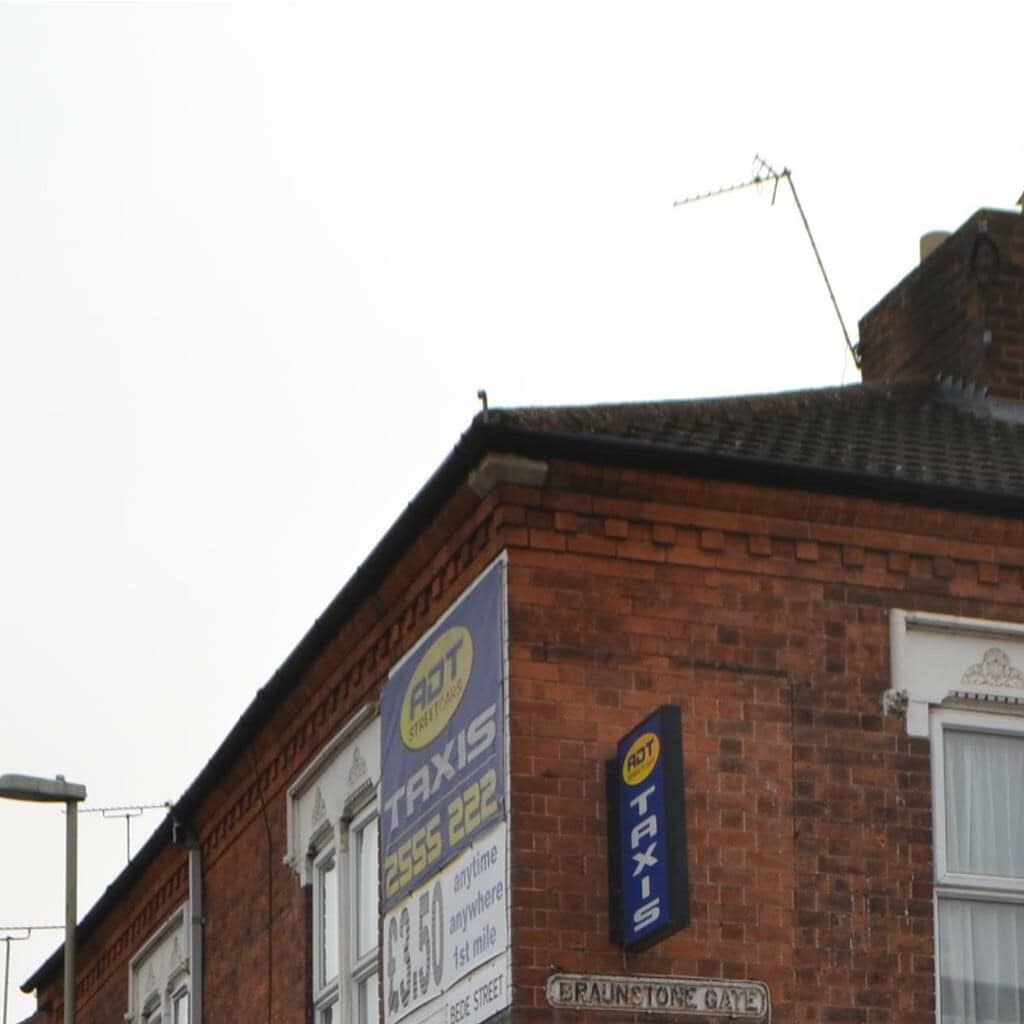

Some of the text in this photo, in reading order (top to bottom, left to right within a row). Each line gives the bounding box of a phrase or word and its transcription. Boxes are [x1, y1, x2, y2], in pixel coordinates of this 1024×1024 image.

[410, 637, 464, 721] ADT
[384, 703, 497, 829] TAXIS
[627, 737, 654, 772] ADT
[384, 768, 499, 898] 2555 222
[629, 784, 661, 932] TAXIS
[453, 845, 498, 893] anytime
[449, 880, 504, 935] anywhere
[453, 923, 497, 969] 1st mile
[474, 974, 504, 1010] STREET
[559, 981, 760, 1011] BRAUNSTONE GATE
